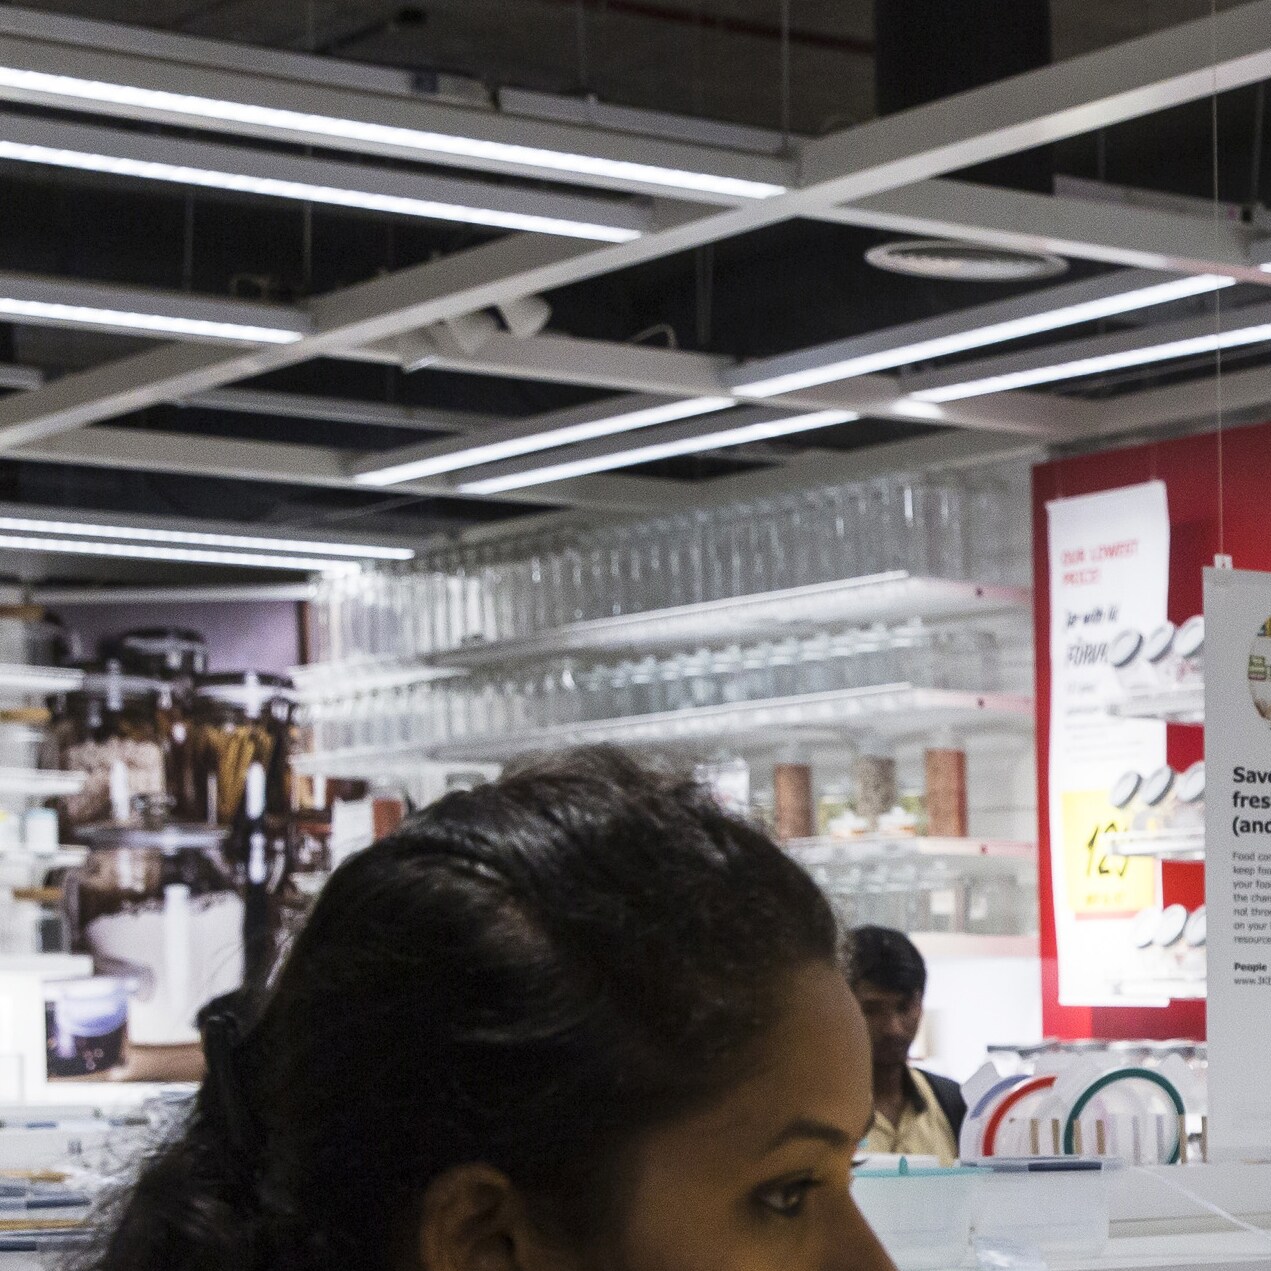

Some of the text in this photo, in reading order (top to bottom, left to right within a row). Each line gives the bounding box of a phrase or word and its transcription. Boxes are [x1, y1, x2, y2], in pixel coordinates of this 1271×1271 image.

[1232, 852, 1255, 861] Food
[1233, 866, 1255, 876] keep
[1233, 880, 1253, 890] your
[1233, 894, 1248, 902] the
[1233, 907, 1248, 917] not
[1233, 922, 1245, 930] on
[1248, 922, 1268, 932] your
[1234, 962, 1268, 973] People
